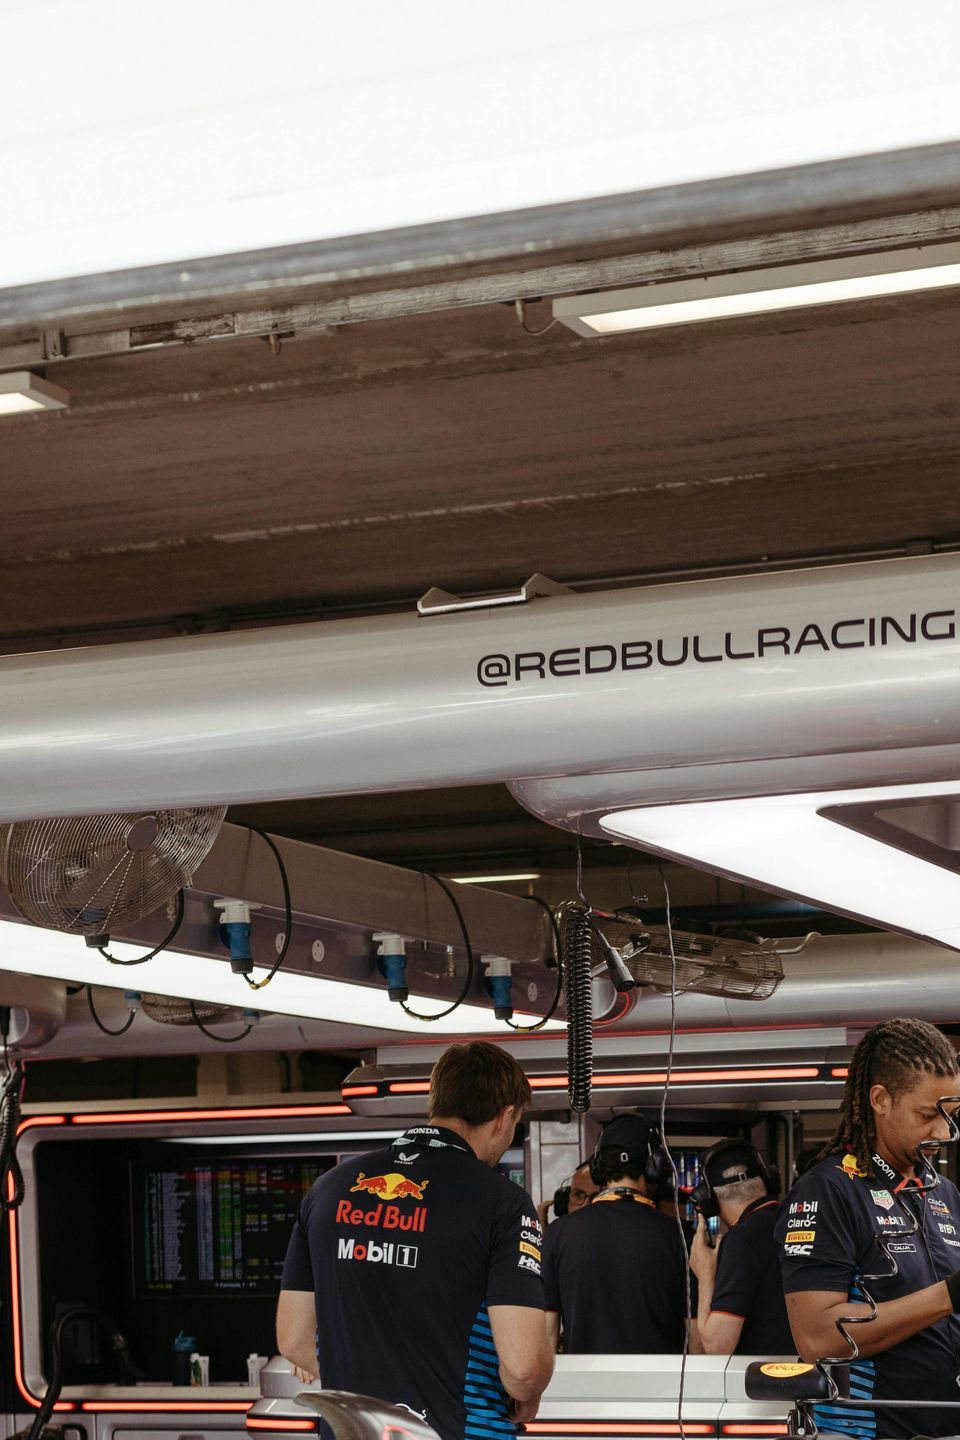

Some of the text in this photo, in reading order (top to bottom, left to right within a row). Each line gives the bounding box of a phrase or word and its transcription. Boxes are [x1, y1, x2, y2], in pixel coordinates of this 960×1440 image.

[477, 609, 956, 687] @REDBULLRACING
[872, 1154, 896, 1180] zoom
[336, 1200, 428, 1232] Red Bull
[789, 1201, 819, 1214] Mobil
[788, 1216, 812, 1228] Claro
[338, 1238, 394, 1265] Mobil
